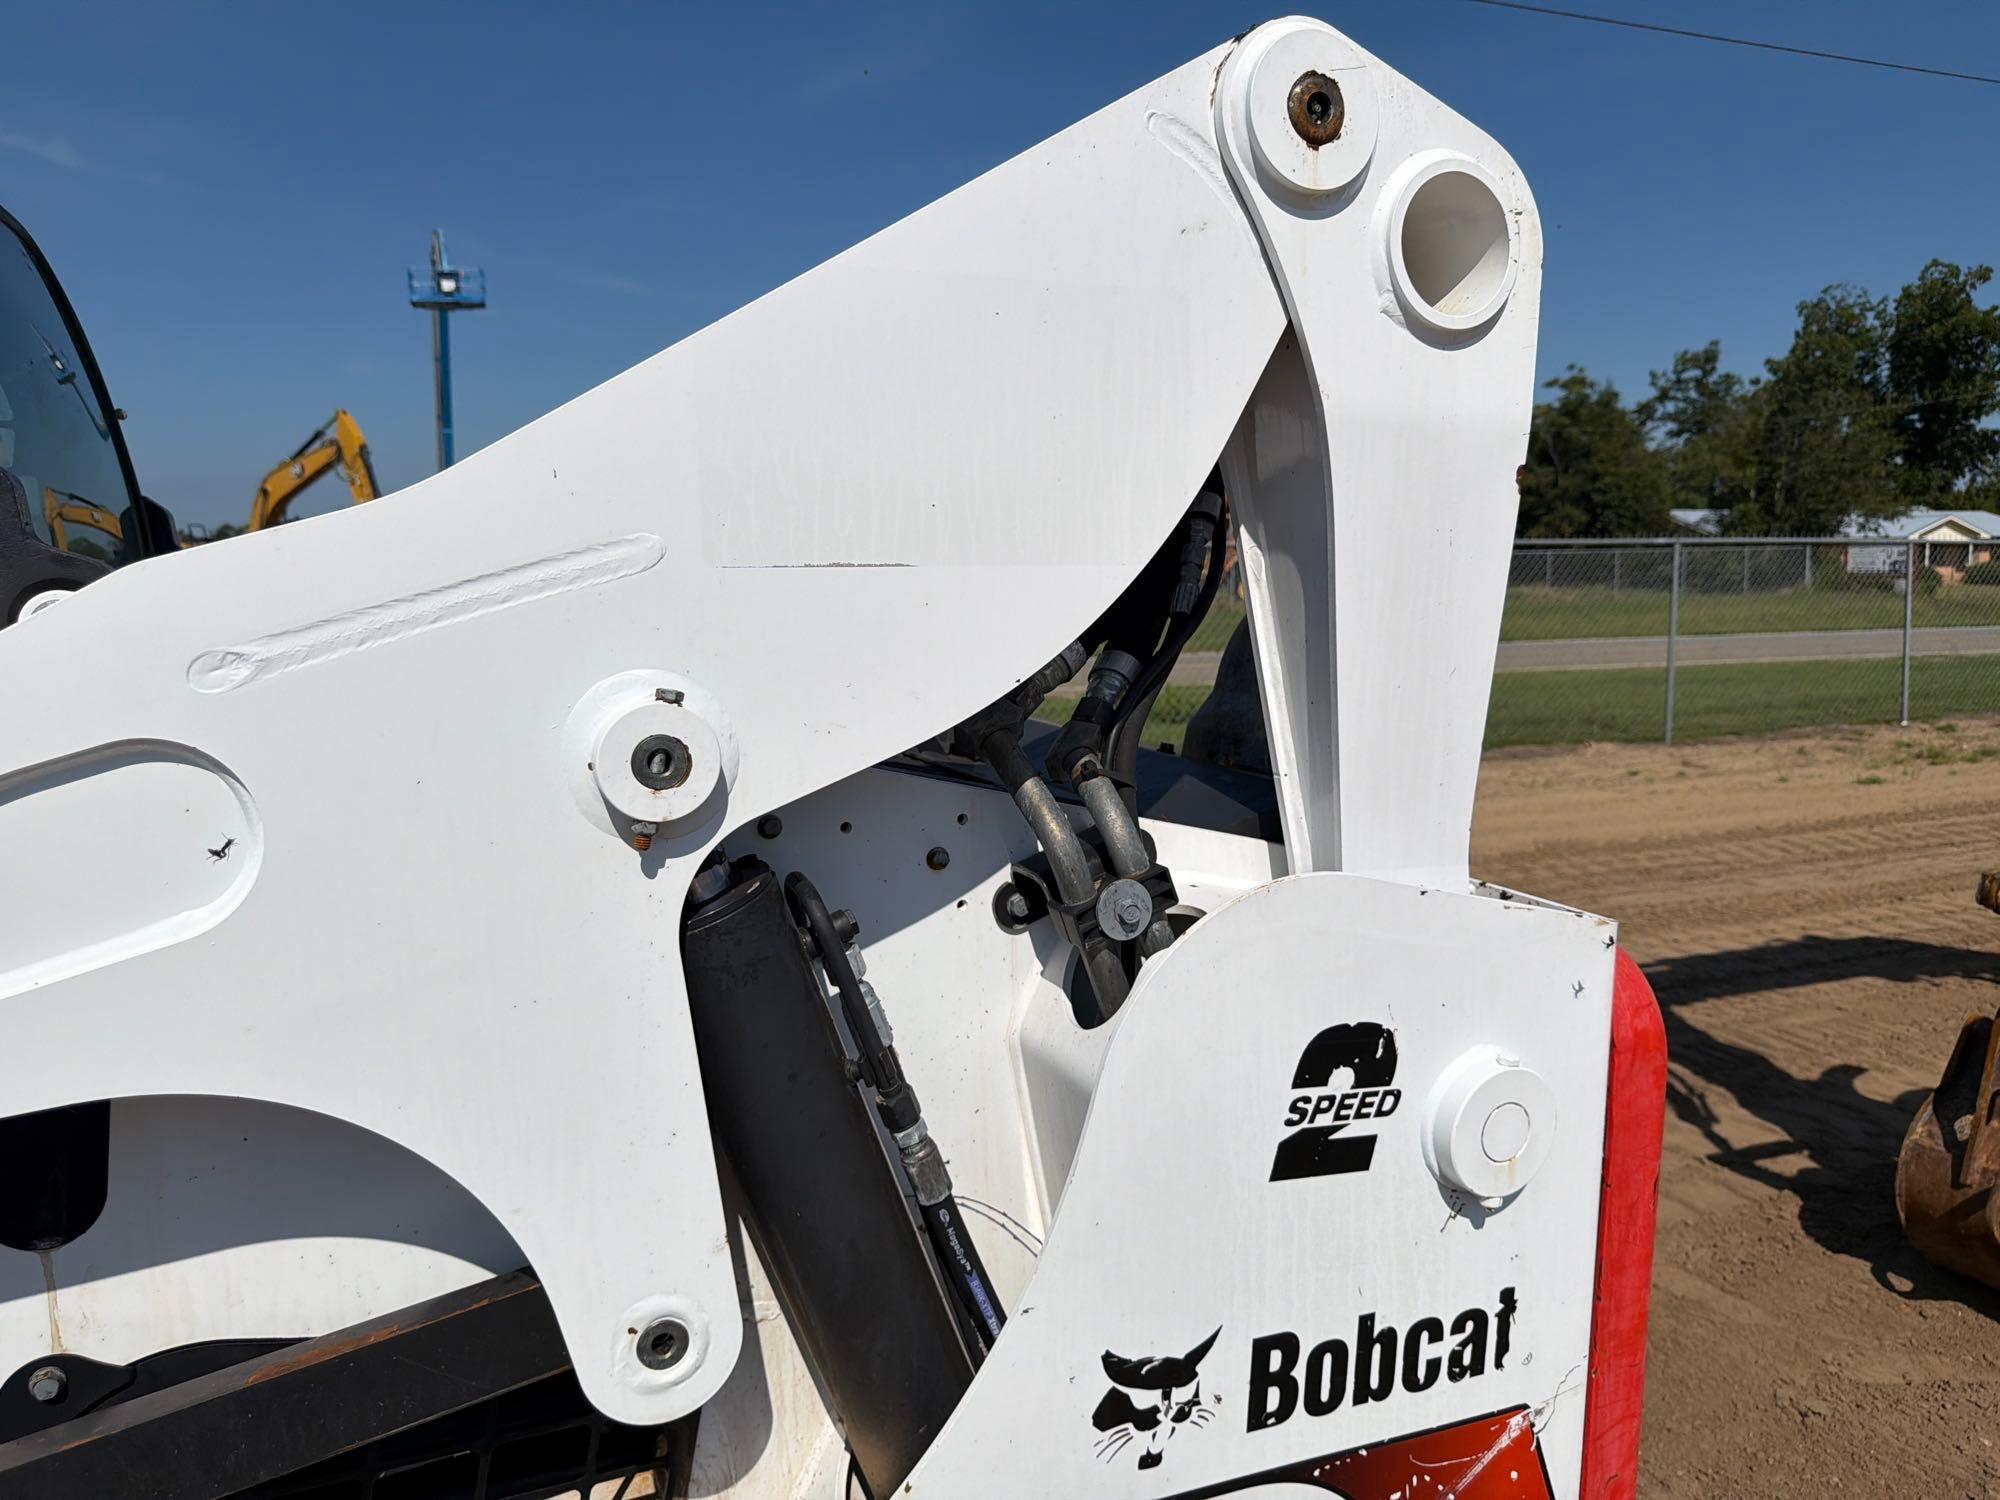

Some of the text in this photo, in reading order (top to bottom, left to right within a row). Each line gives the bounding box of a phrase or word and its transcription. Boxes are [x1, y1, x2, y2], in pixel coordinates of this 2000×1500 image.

[1268, 1021, 1398, 1182] 2
[1283, 1088, 1402, 1127] SPEED
[1246, 1286, 1518, 1434] Bobcat
